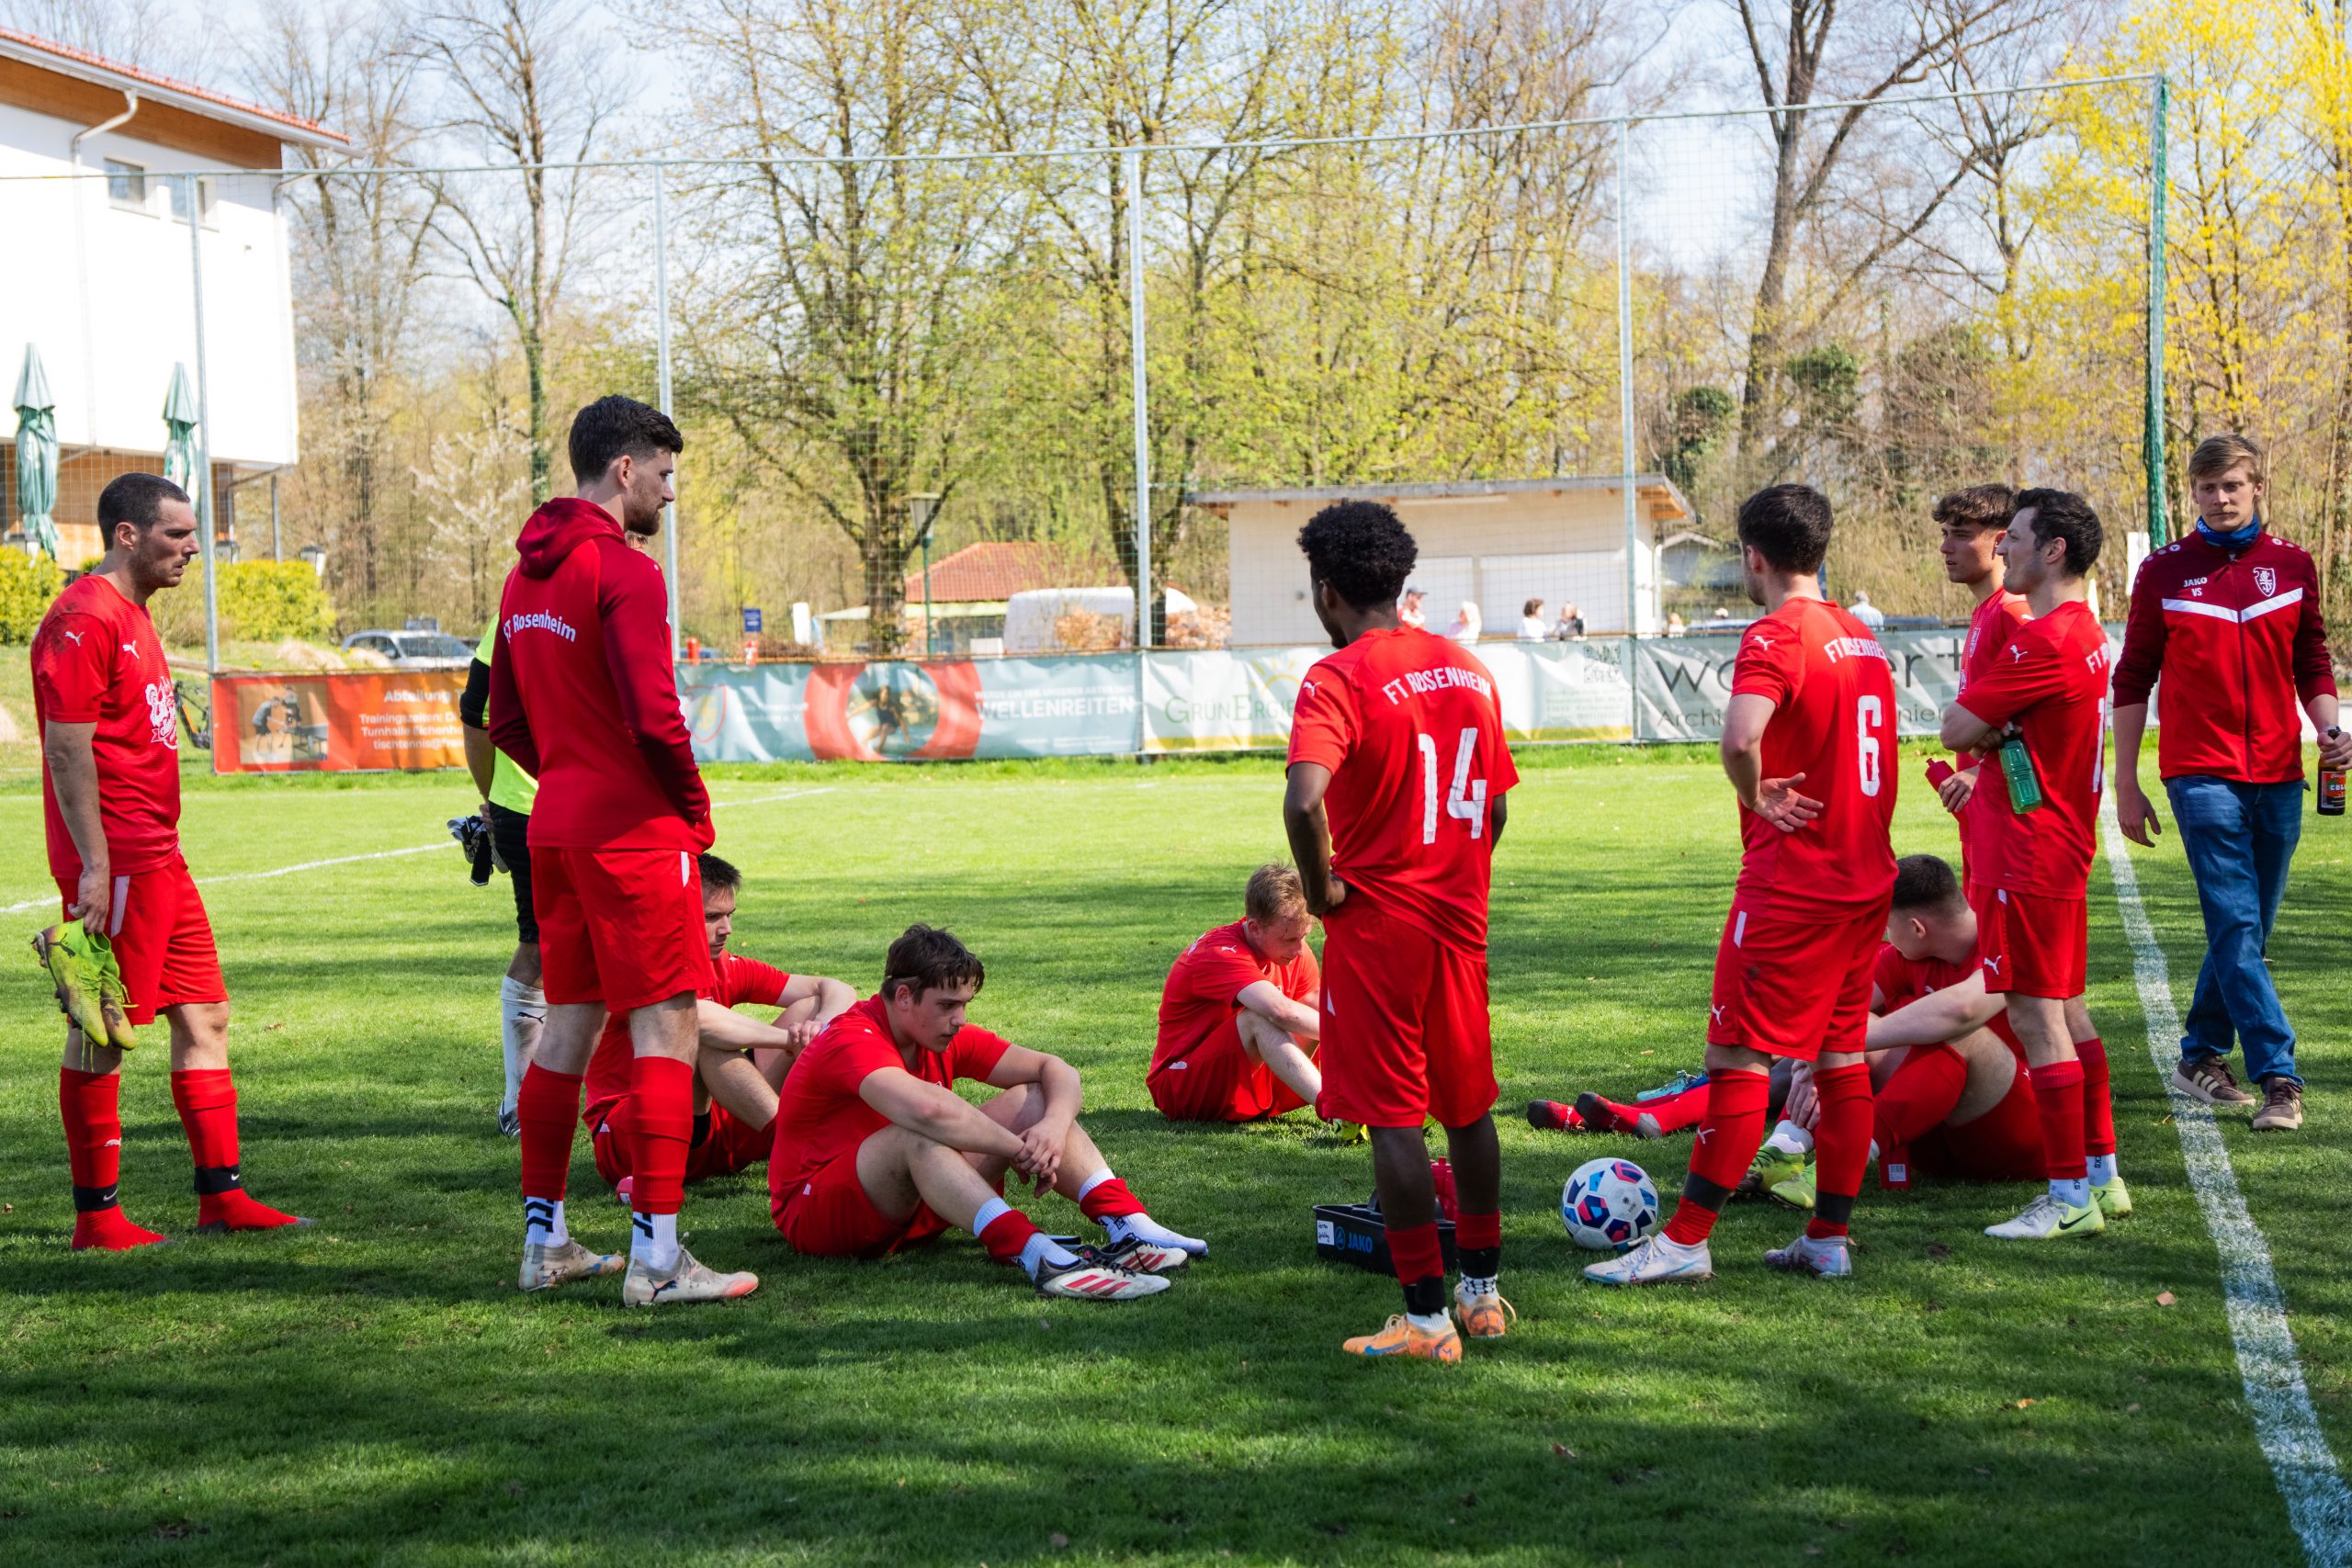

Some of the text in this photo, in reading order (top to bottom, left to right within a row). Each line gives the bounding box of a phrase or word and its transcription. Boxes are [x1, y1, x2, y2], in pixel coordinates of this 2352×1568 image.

[2183, 577, 2208, 587] JAKO
[2191, 588, 2202, 596] VS
[513, 609, 576, 642] Rosenheim
[1824, 637, 1844, 663] FT
[383, 689, 451, 705] Abteilung
[1382, 667, 1492, 705] FT ROSENHEIM
[975, 695, 1136, 720] WELLENREITEN
[361, 726, 410, 737] Turnhalle
[1858, 695, 1882, 796] 6
[1418, 727, 1487, 844] 14
[1348, 1232, 1373, 1254] JAKO
